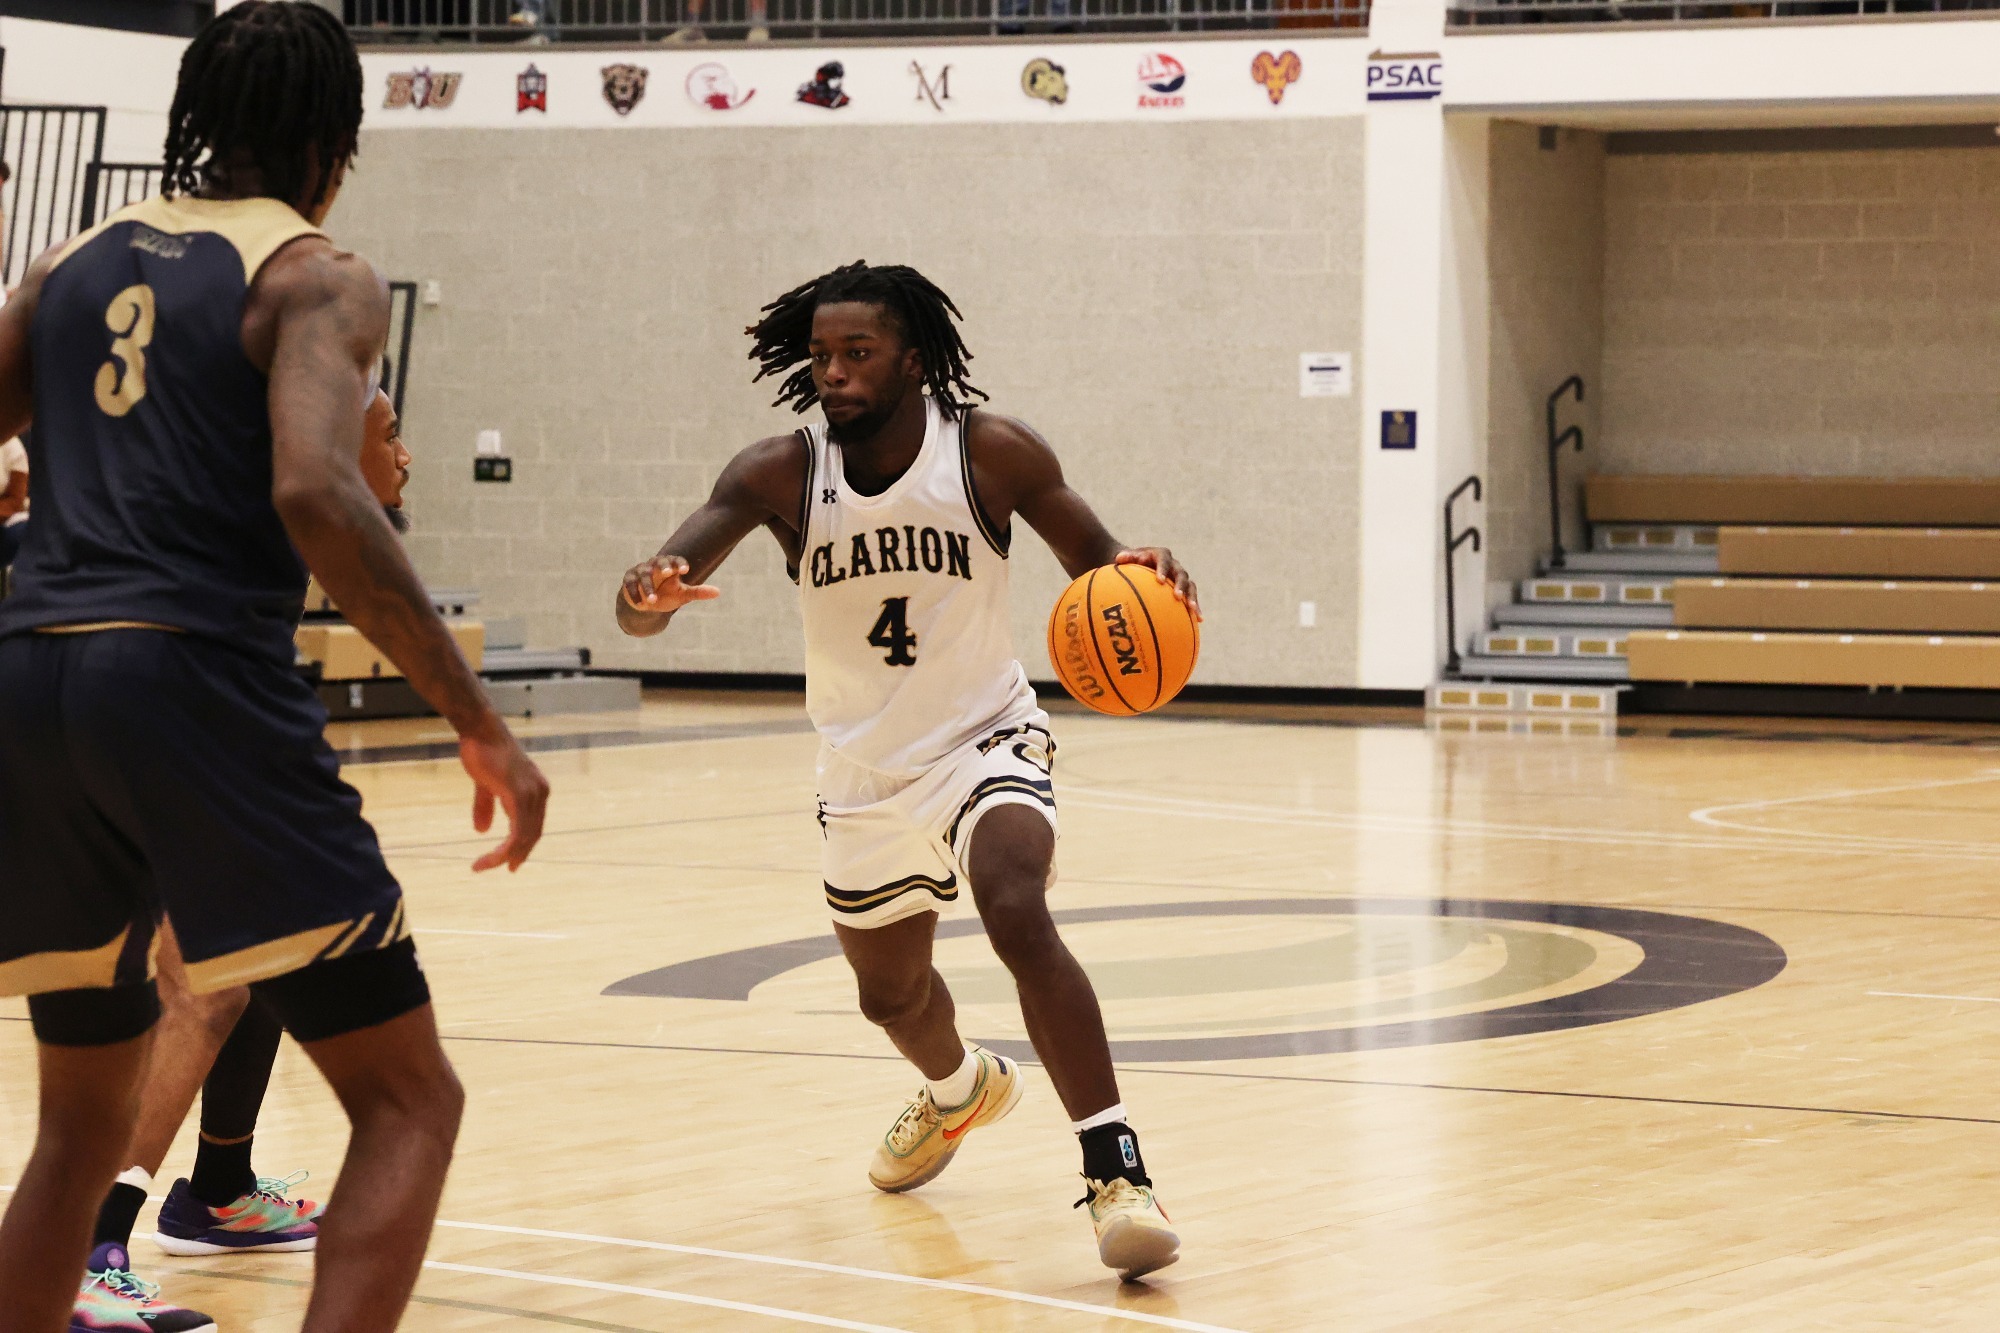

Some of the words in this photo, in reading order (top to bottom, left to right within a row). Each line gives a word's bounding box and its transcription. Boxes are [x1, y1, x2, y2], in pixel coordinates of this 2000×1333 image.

[1366, 64, 1442, 87] PSAC
[94, 284, 156, 417] 3
[811, 525, 972, 587] CLARION
[867, 597, 917, 666] 4
[1102, 603, 1142, 675] NCAA
